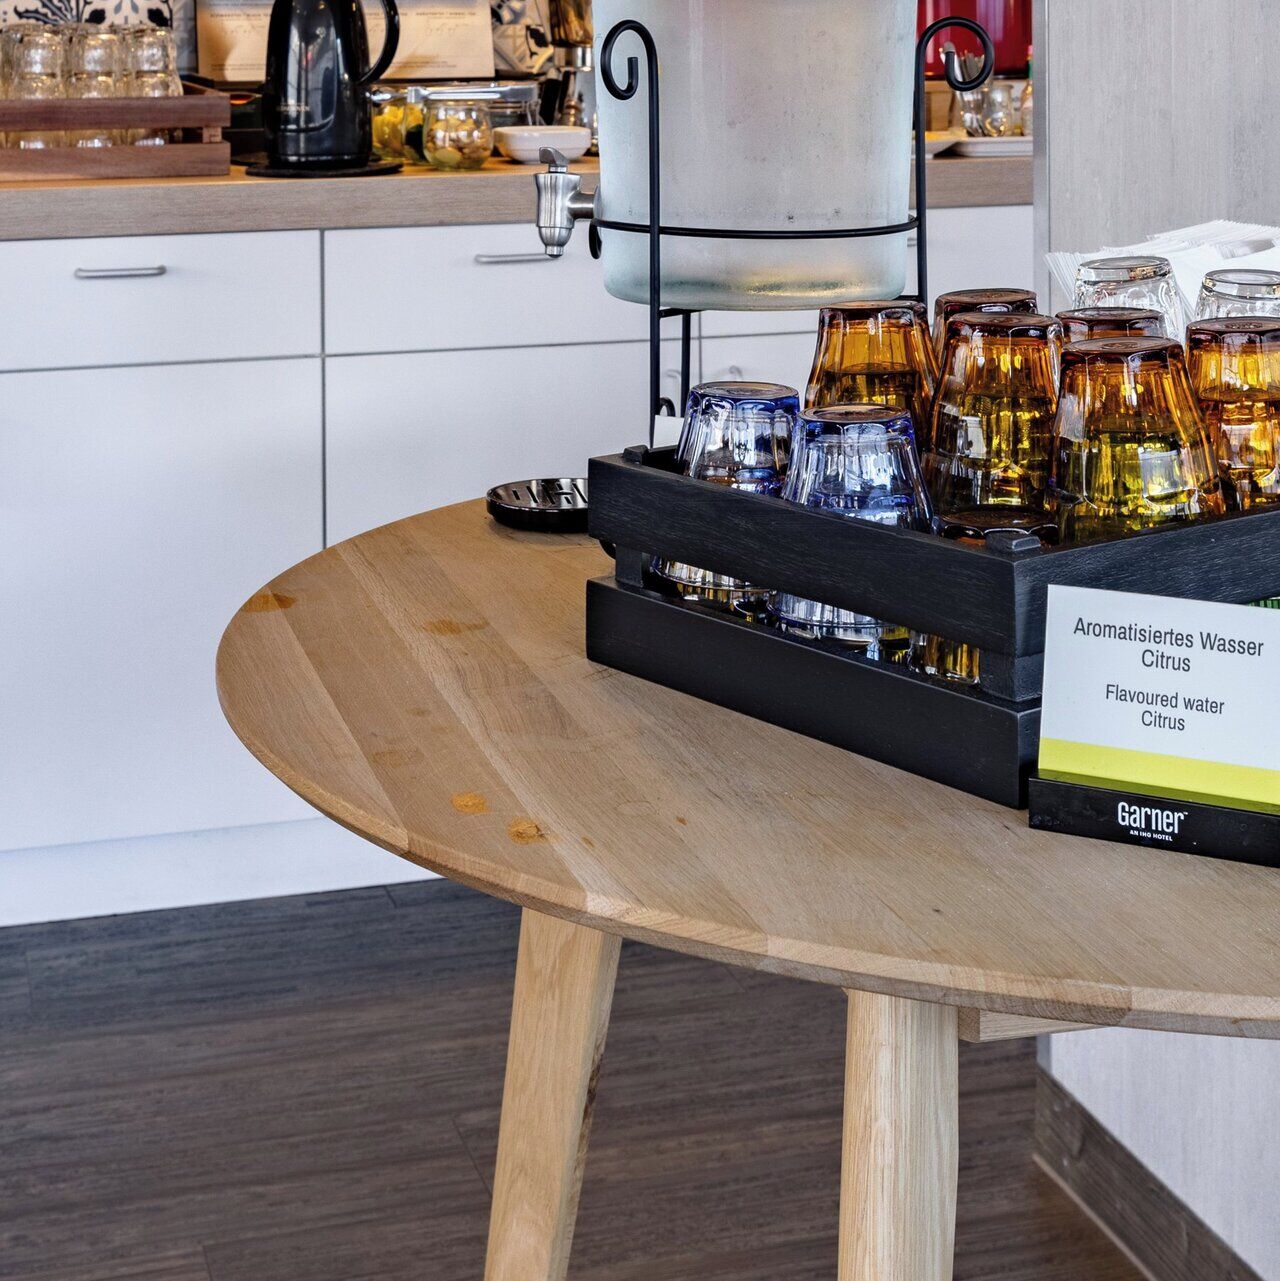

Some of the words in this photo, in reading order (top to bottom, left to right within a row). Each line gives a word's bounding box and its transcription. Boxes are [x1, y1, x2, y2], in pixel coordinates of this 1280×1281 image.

[1073, 617, 1194, 649] Aromatisiertes
[1199, 631, 1264, 657] Wasser
[1141, 649, 1191, 672] Citrus
[1105, 684, 1179, 708] Flavoured
[1183, 696, 1225, 715] water
[1141, 710, 1186, 731] Citrus
[1117, 801, 1185, 834] Garner
[1152, 833, 1173, 842] HOTEL
